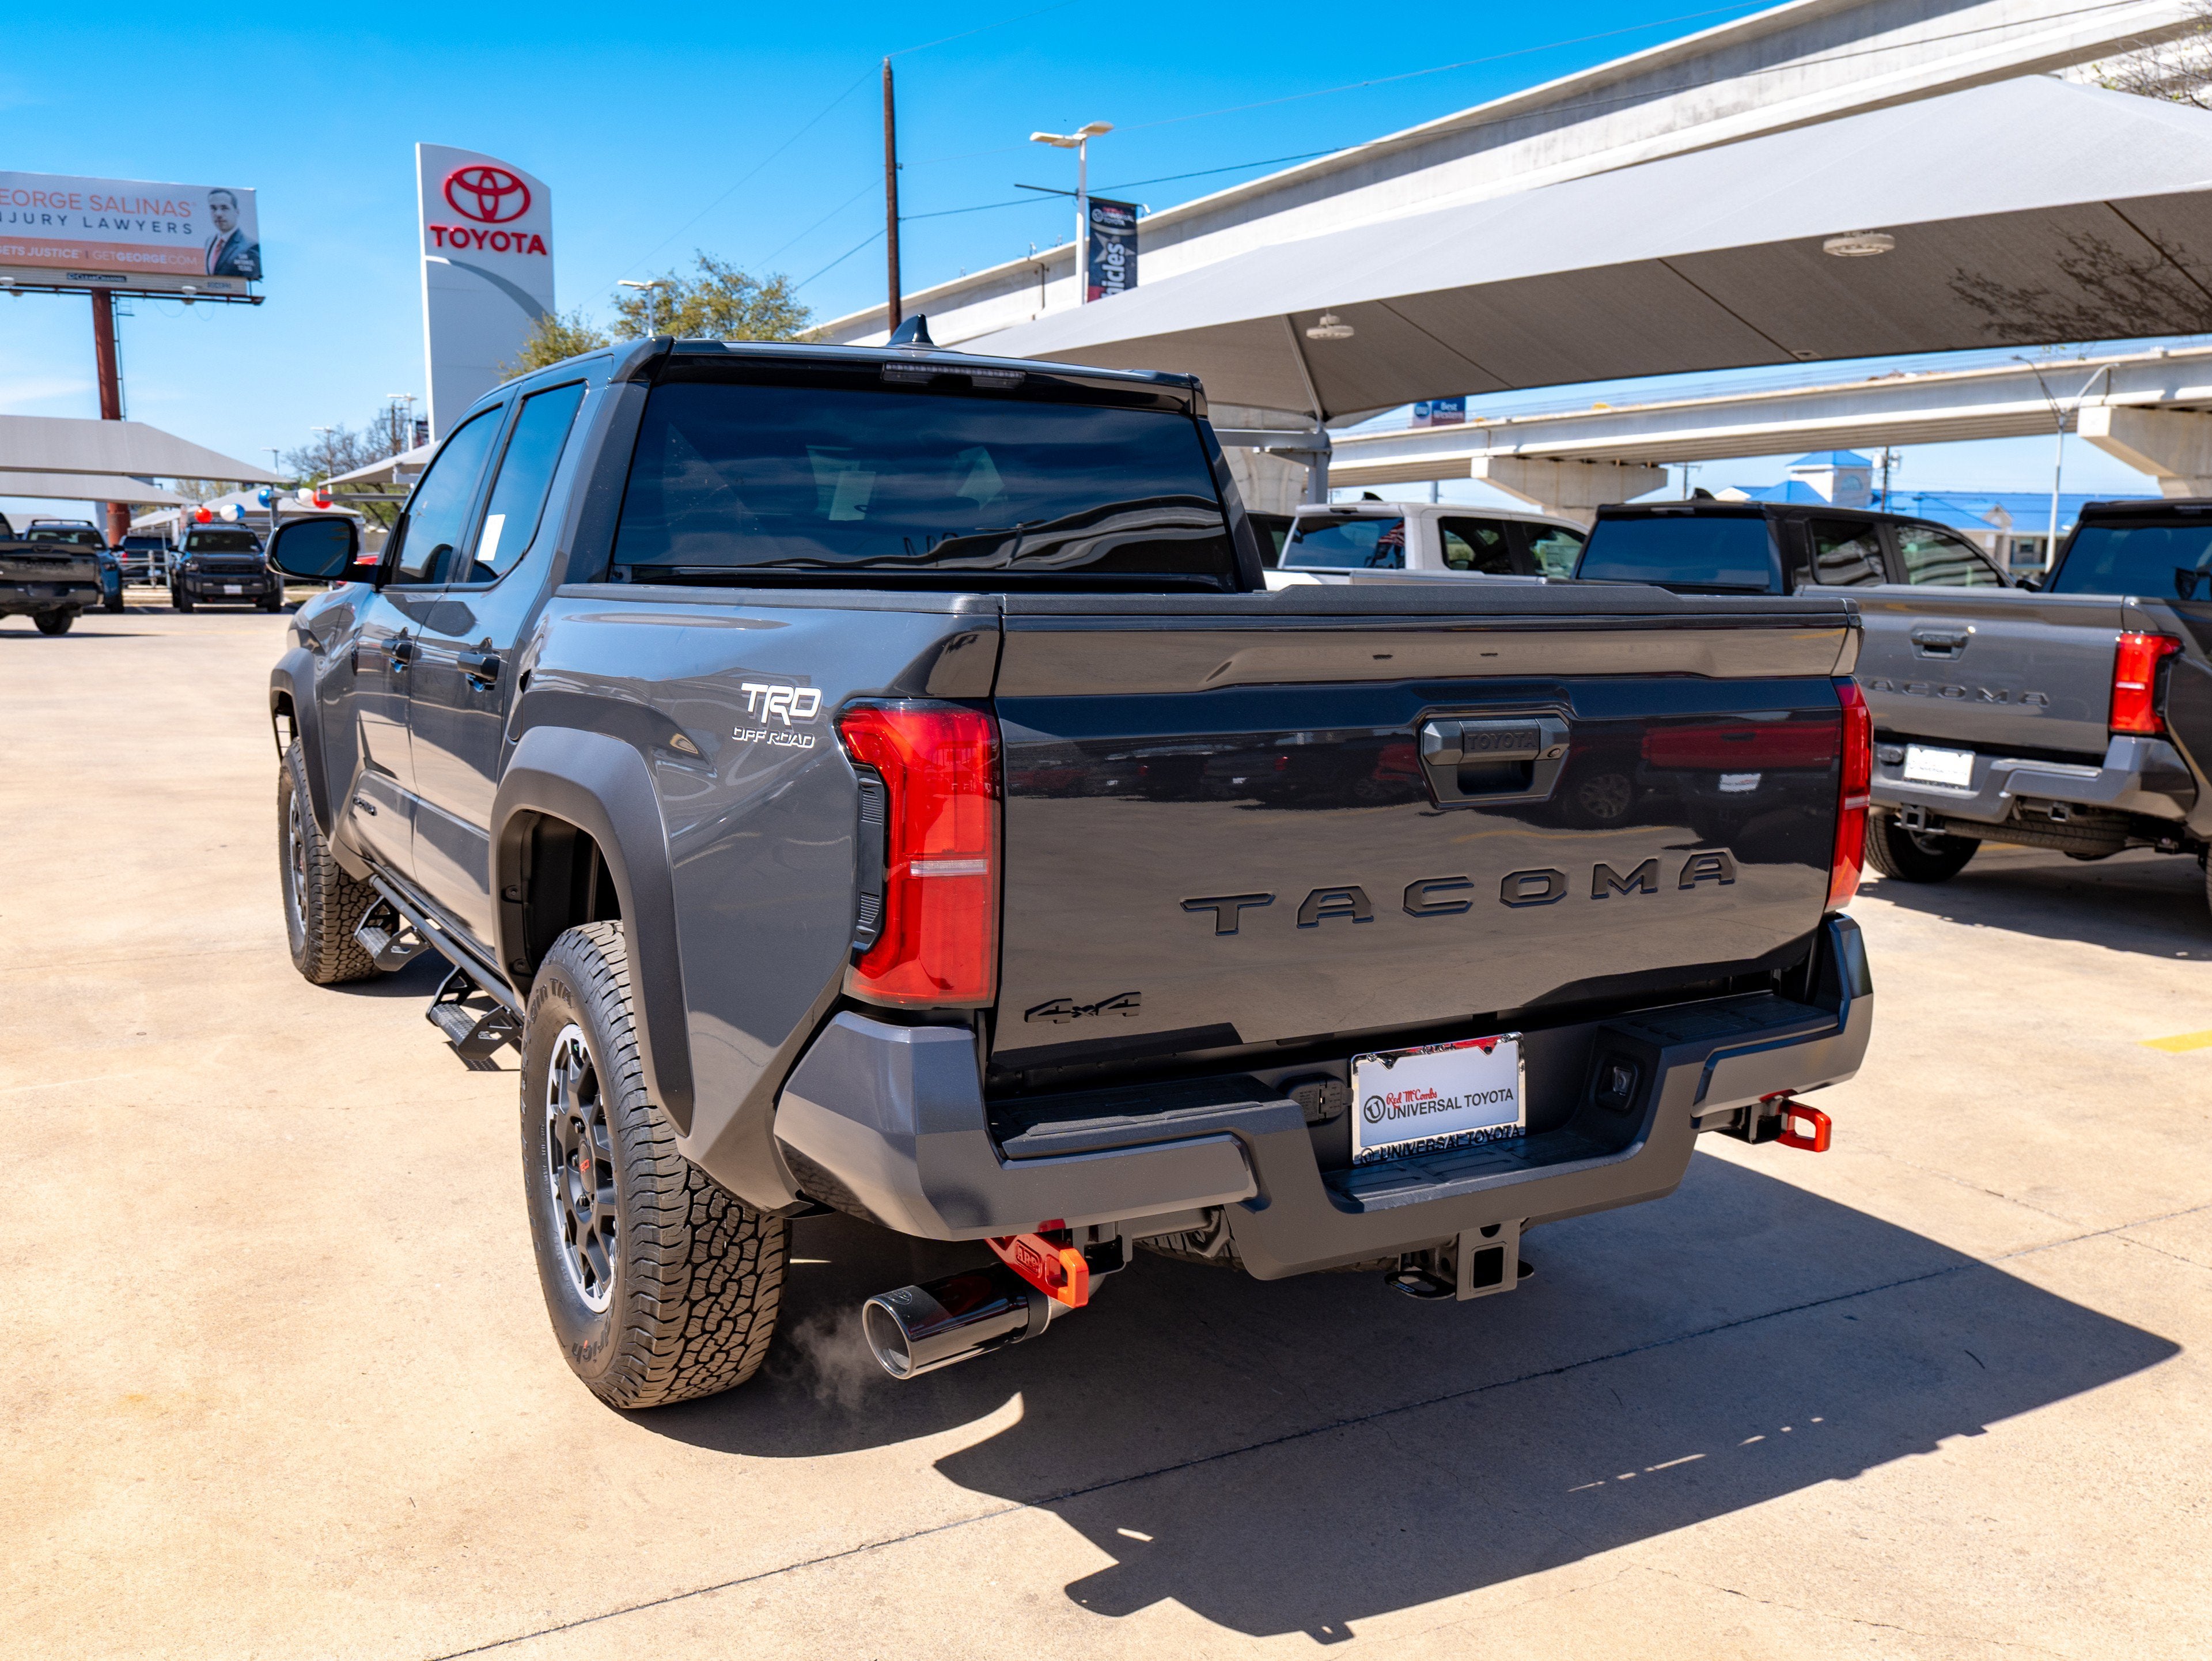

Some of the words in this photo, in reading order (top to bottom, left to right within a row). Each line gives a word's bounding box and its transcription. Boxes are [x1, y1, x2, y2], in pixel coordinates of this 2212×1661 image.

[89, 194, 192, 218] SALINAS
[0, 210, 67, 226] JURY
[83, 216, 192, 234] LAWYERS
[0, 244, 25, 256] ETS
[27, 247, 79, 259] JUSTICE
[430, 225, 547, 255] TOYOTA
[741, 682, 822, 726] TRD
[1858, 676, 2050, 708] ACOMA
[732, 727, 767, 743] OFF
[767, 732, 816, 748] ROAD
[1468, 732, 1536, 750] TOYOTA
[1180, 848, 1736, 936] TACOMA
[1387, 1092, 1402, 1108] Red
[1387, 1096, 1462, 1121] UNIVERSAL
[1464, 1088, 1514, 1107] TOYOTA
[1379, 1134, 1463, 1161] UNIVERSAL
[1464, 1124, 1521, 1145] TOYOTA
